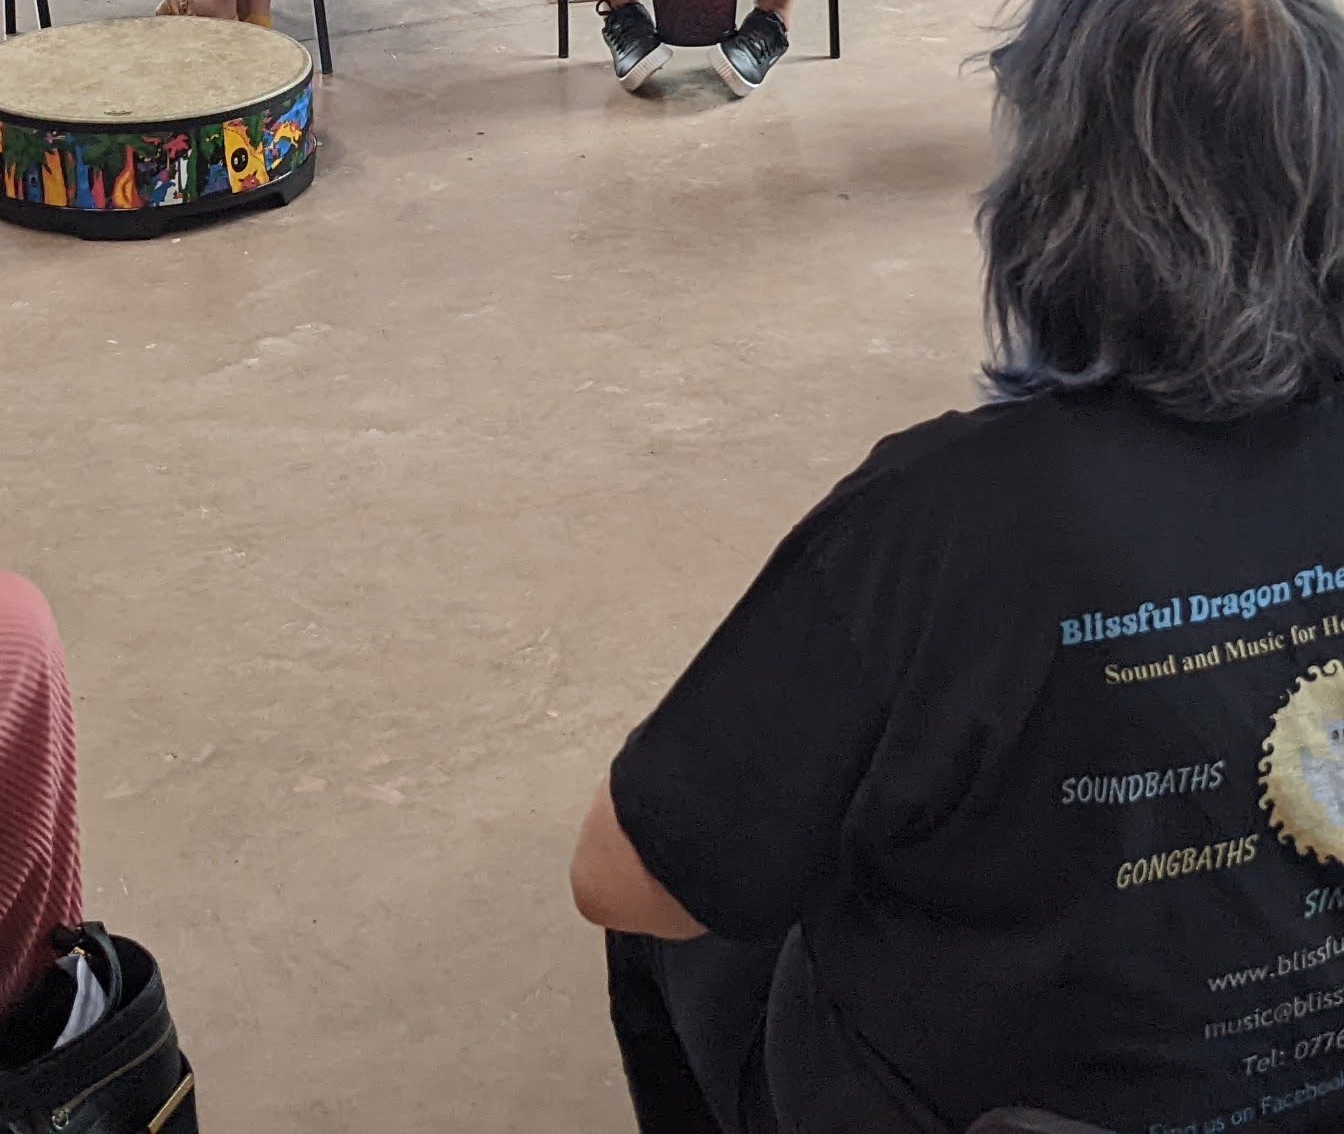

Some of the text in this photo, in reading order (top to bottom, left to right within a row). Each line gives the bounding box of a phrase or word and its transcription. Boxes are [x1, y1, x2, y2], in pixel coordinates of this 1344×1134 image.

[1060, 597, 1183, 646] Blissful
[1188, 580, 1292, 619] Dragon
[1105, 654, 1177, 685] Sound
[1182, 645, 1221, 672] and
[1225, 630, 1285, 662] Music
[1290, 625, 1316, 646] for
[1061, 760, 1226, 805] SOUNDBATHS
[1116, 833, 1259, 889] GONGBATHS
[1242, 1048, 1286, 1076] Tel:
[1231, 1105, 1256, 1126] on
